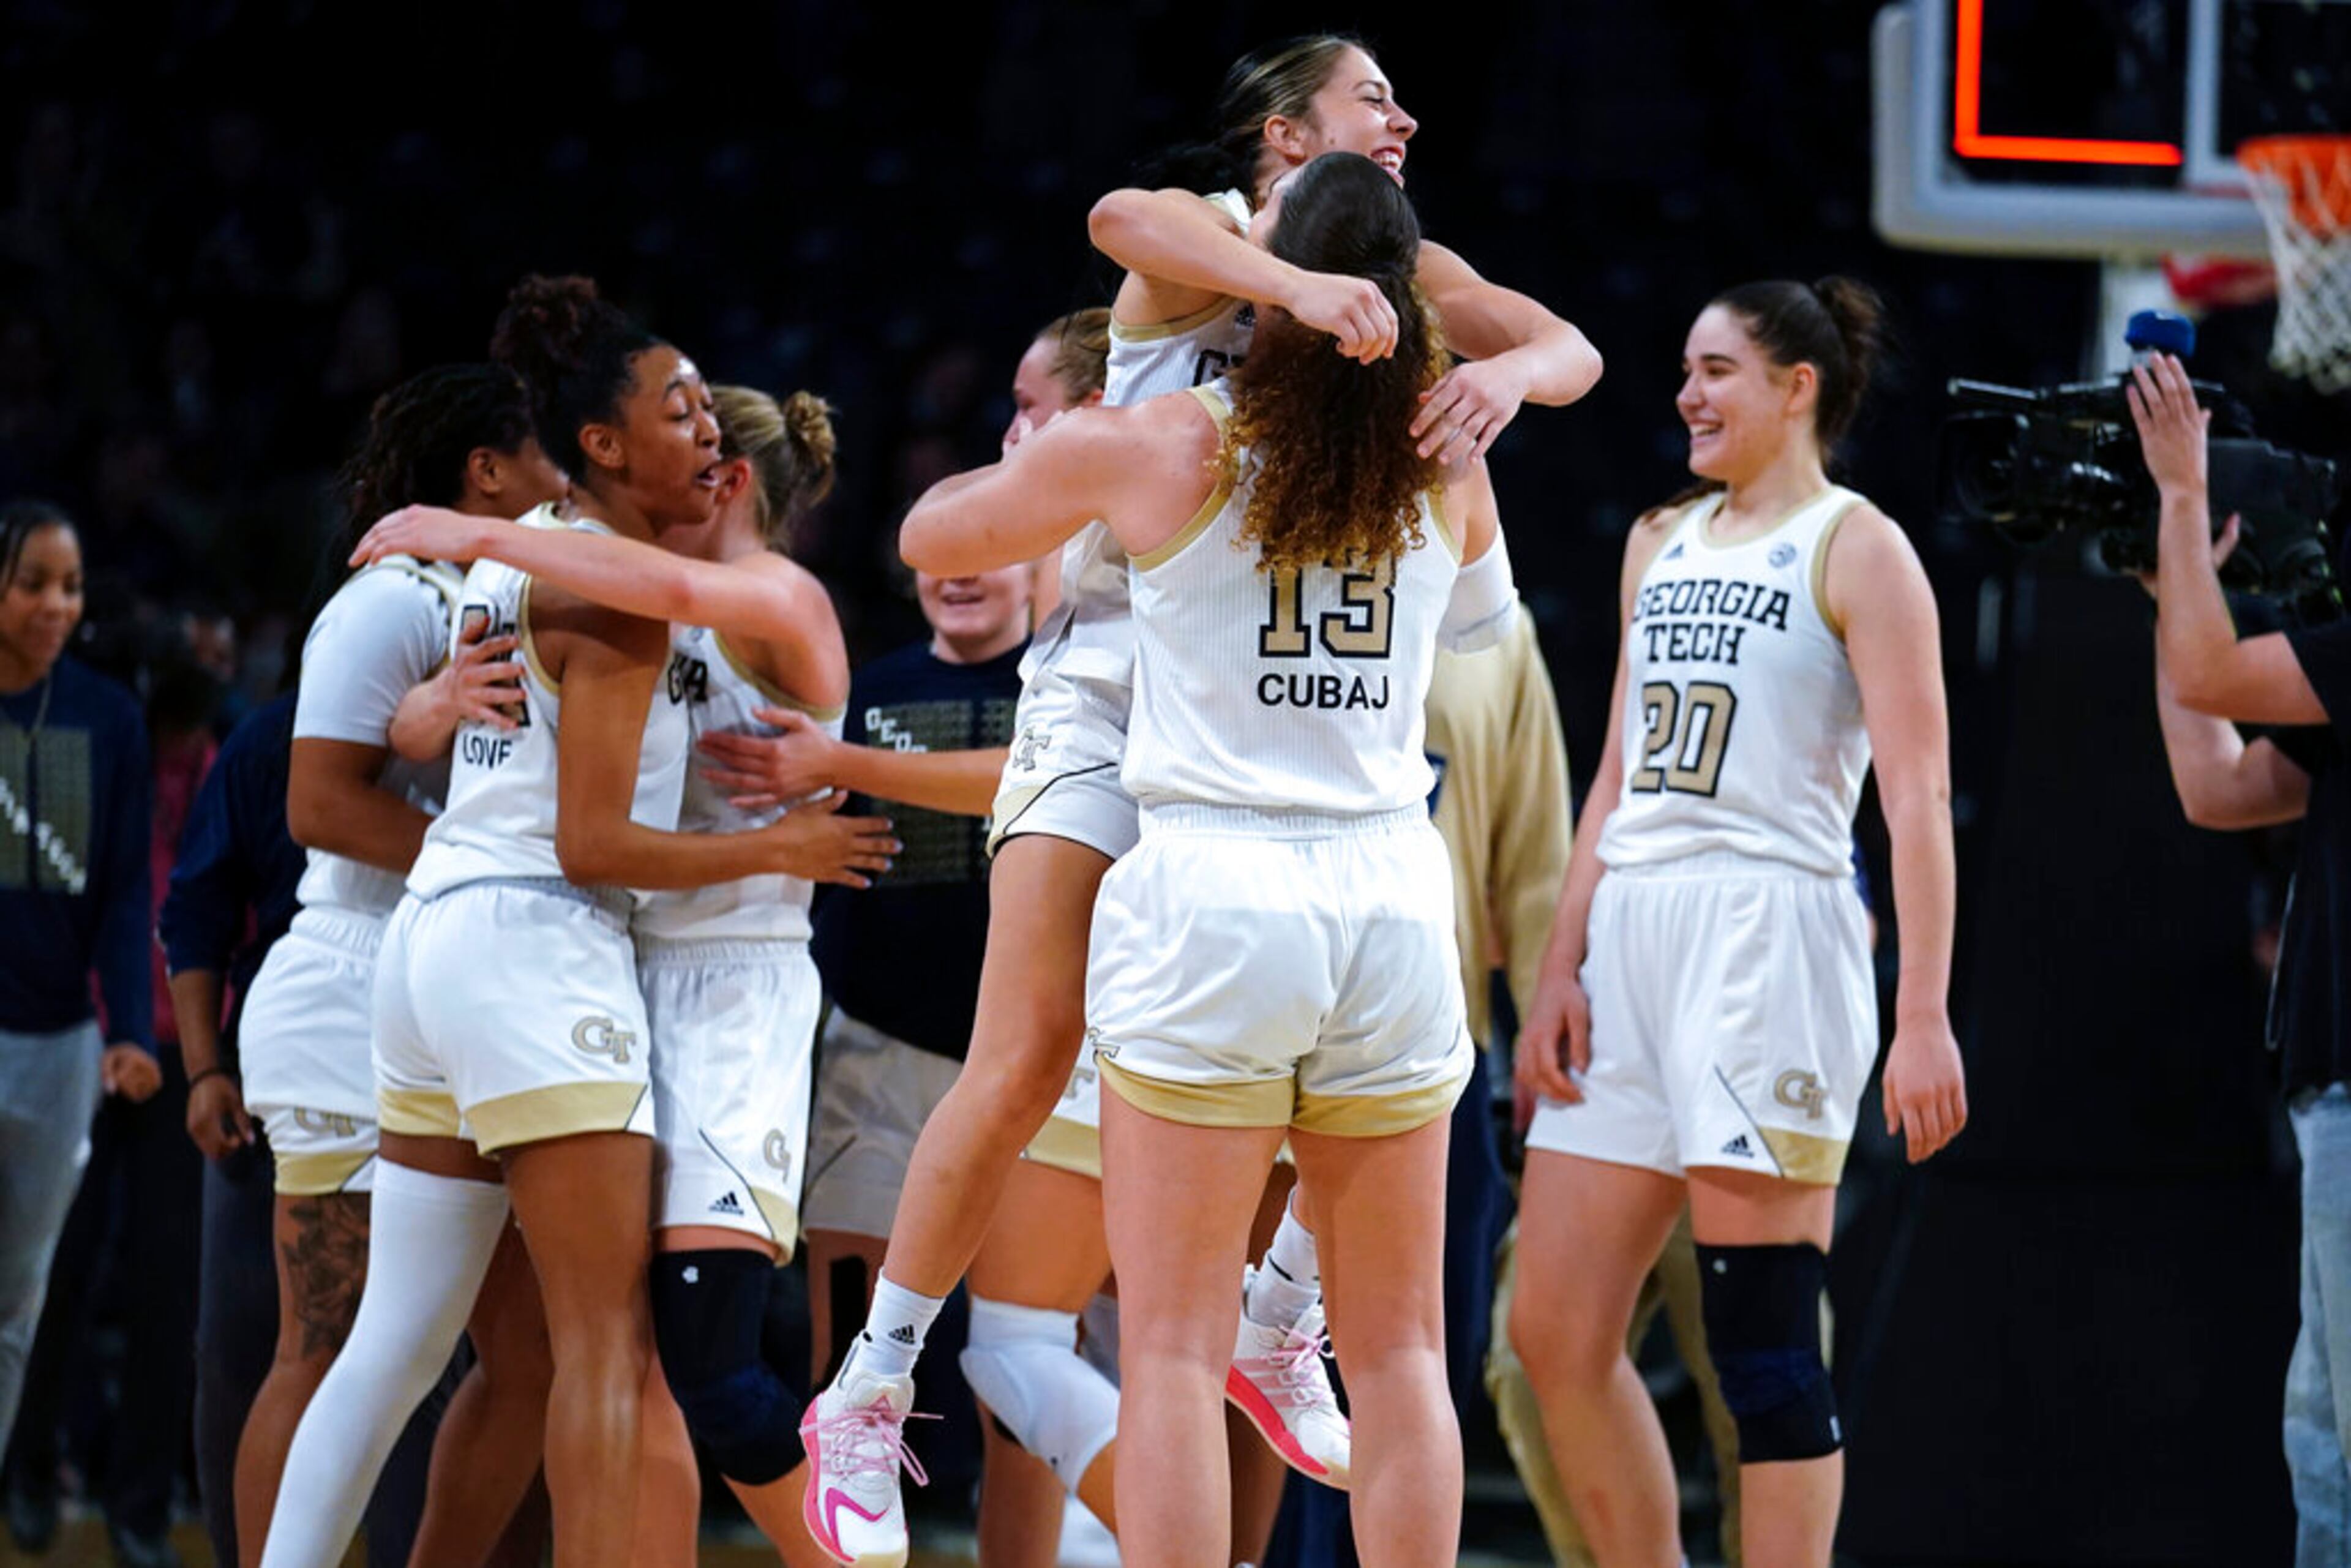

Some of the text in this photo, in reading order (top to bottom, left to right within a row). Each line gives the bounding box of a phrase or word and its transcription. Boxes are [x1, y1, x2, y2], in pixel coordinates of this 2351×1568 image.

[1259, 547, 1397, 658] 13
[1644, 623, 1746, 665] TECH
[1257, 673, 1389, 710] CUBAJ
[1631, 680, 1738, 798] 20
[571, 1016, 636, 1064] GT
